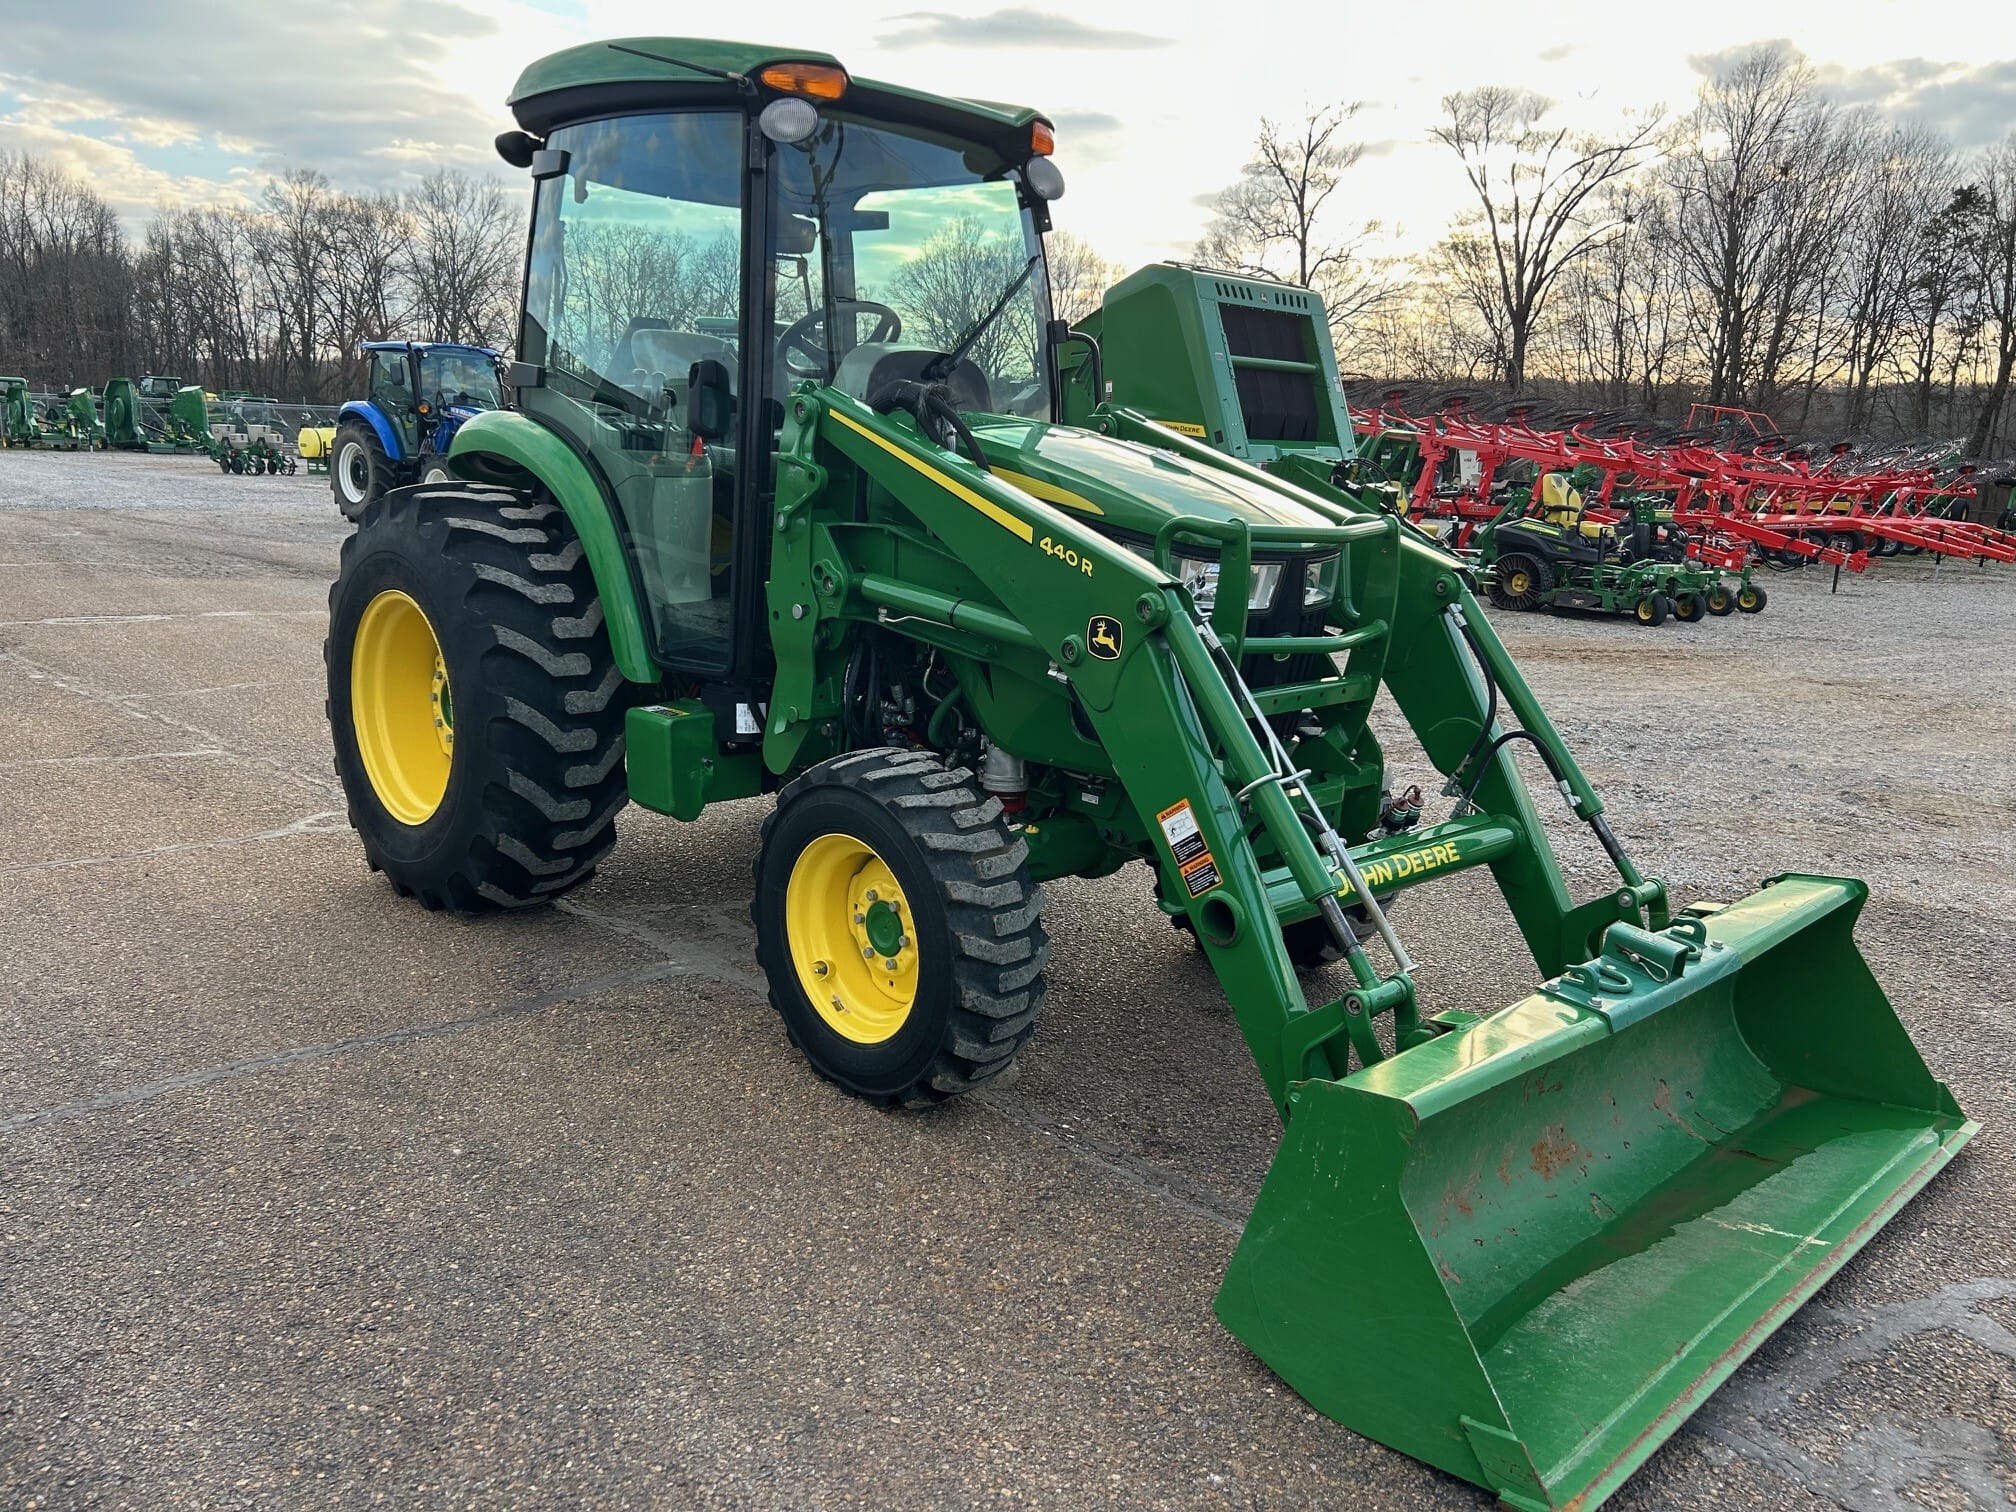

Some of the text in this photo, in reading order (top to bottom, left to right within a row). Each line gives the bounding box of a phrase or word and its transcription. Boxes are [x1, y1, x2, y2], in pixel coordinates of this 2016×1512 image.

[1180, 425, 1200, 433] DEERE
[1335, 841, 1460, 898] JHN DEERE
